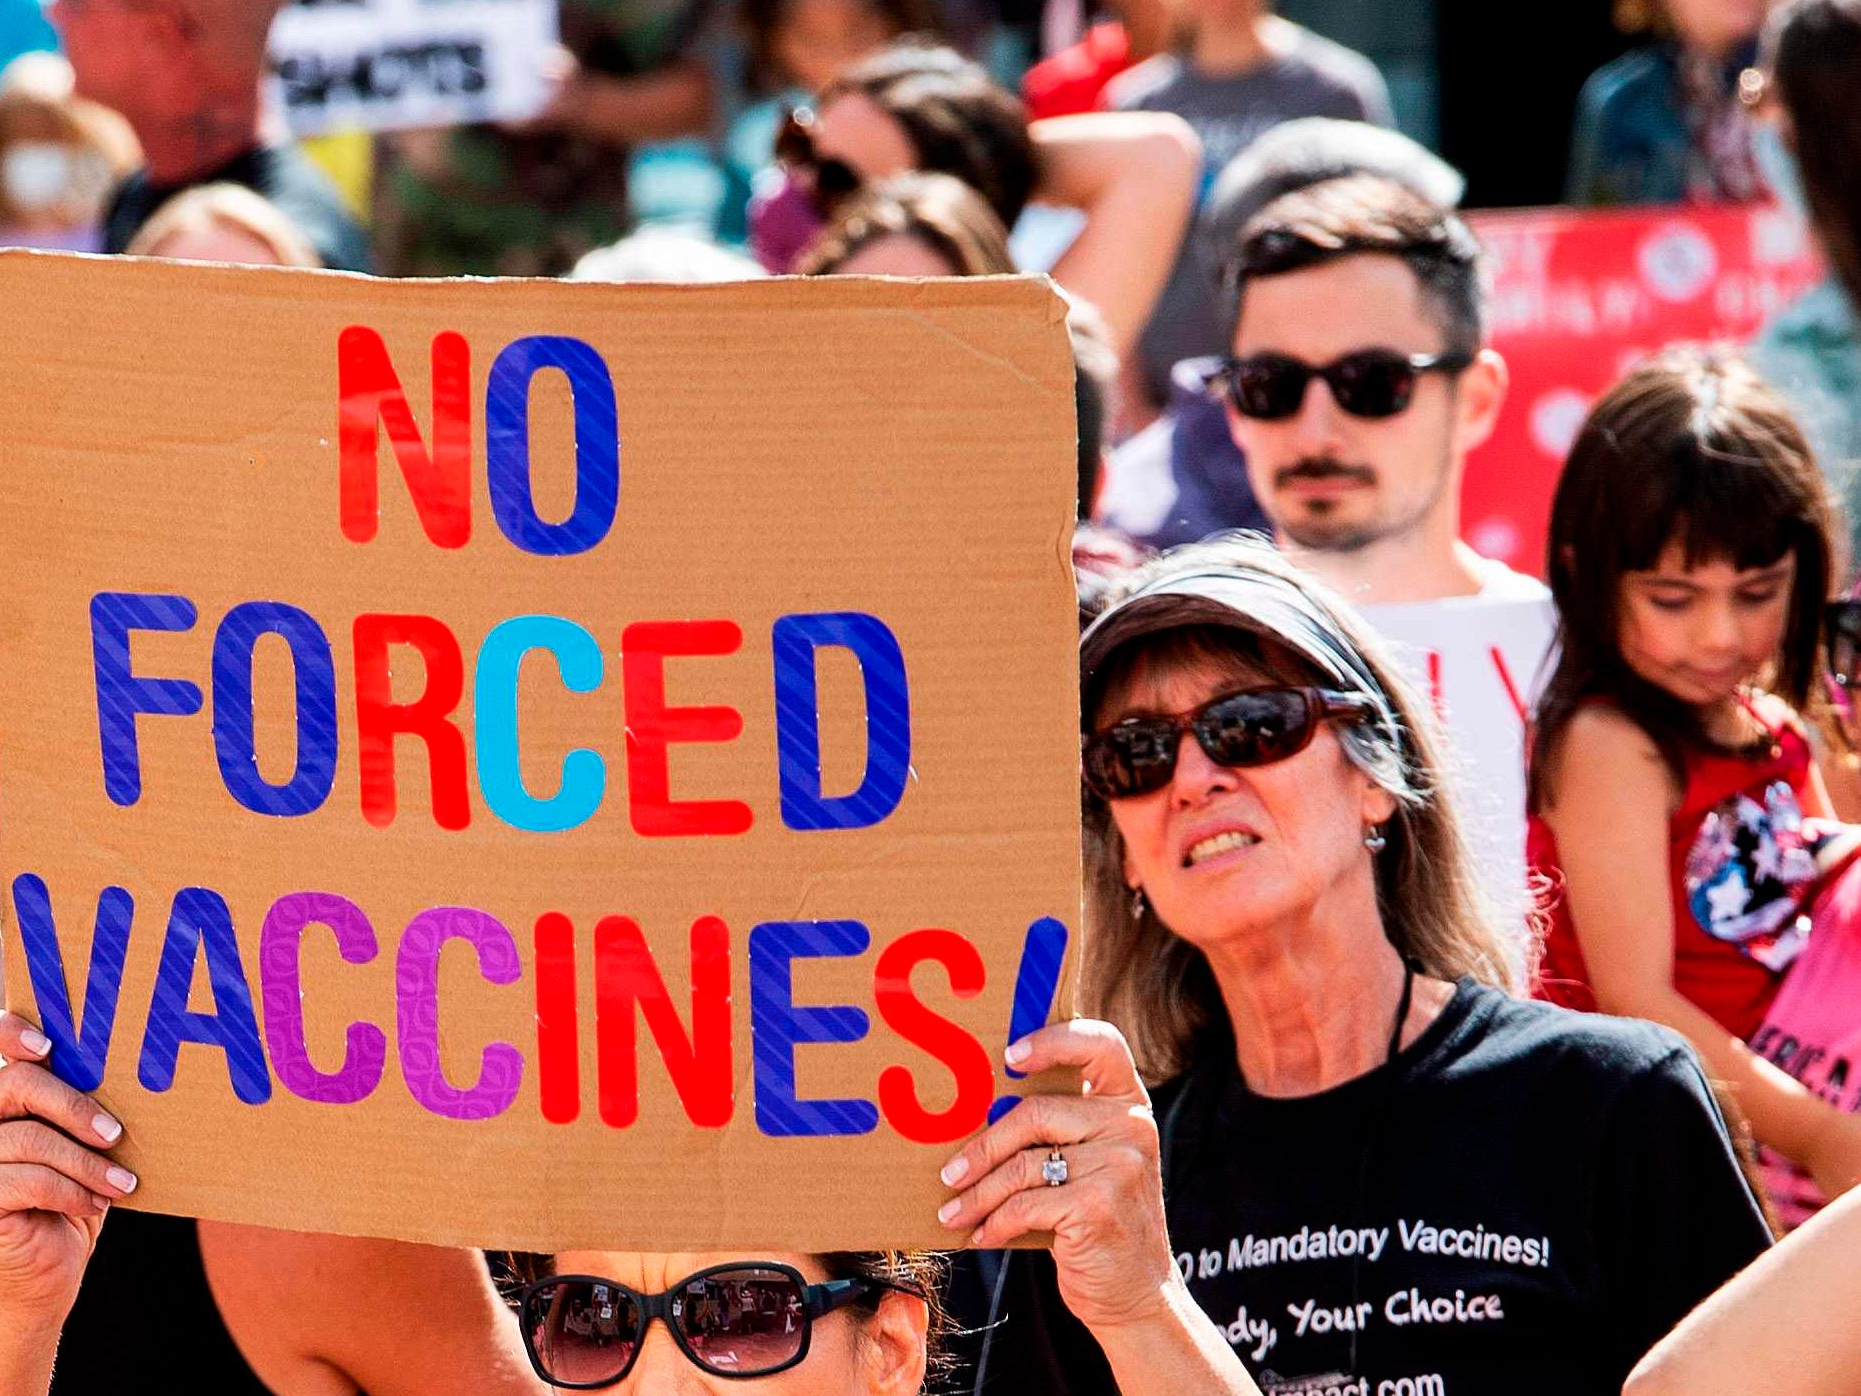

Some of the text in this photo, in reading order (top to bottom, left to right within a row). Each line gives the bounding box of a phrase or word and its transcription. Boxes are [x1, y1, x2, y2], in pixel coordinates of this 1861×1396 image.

[338, 324, 620, 556] NO
[89, 591, 912, 838] FORCED
[11, 871, 1068, 1146] VACCINES!
[1198, 1247, 1222, 1280] to
[1227, 1224, 1389, 1272] Mandatory
[1397, 1218, 1549, 1268] Vaccines!
[1286, 1298, 1373, 1338] Your
[1384, 1287, 1505, 1326] Choice
